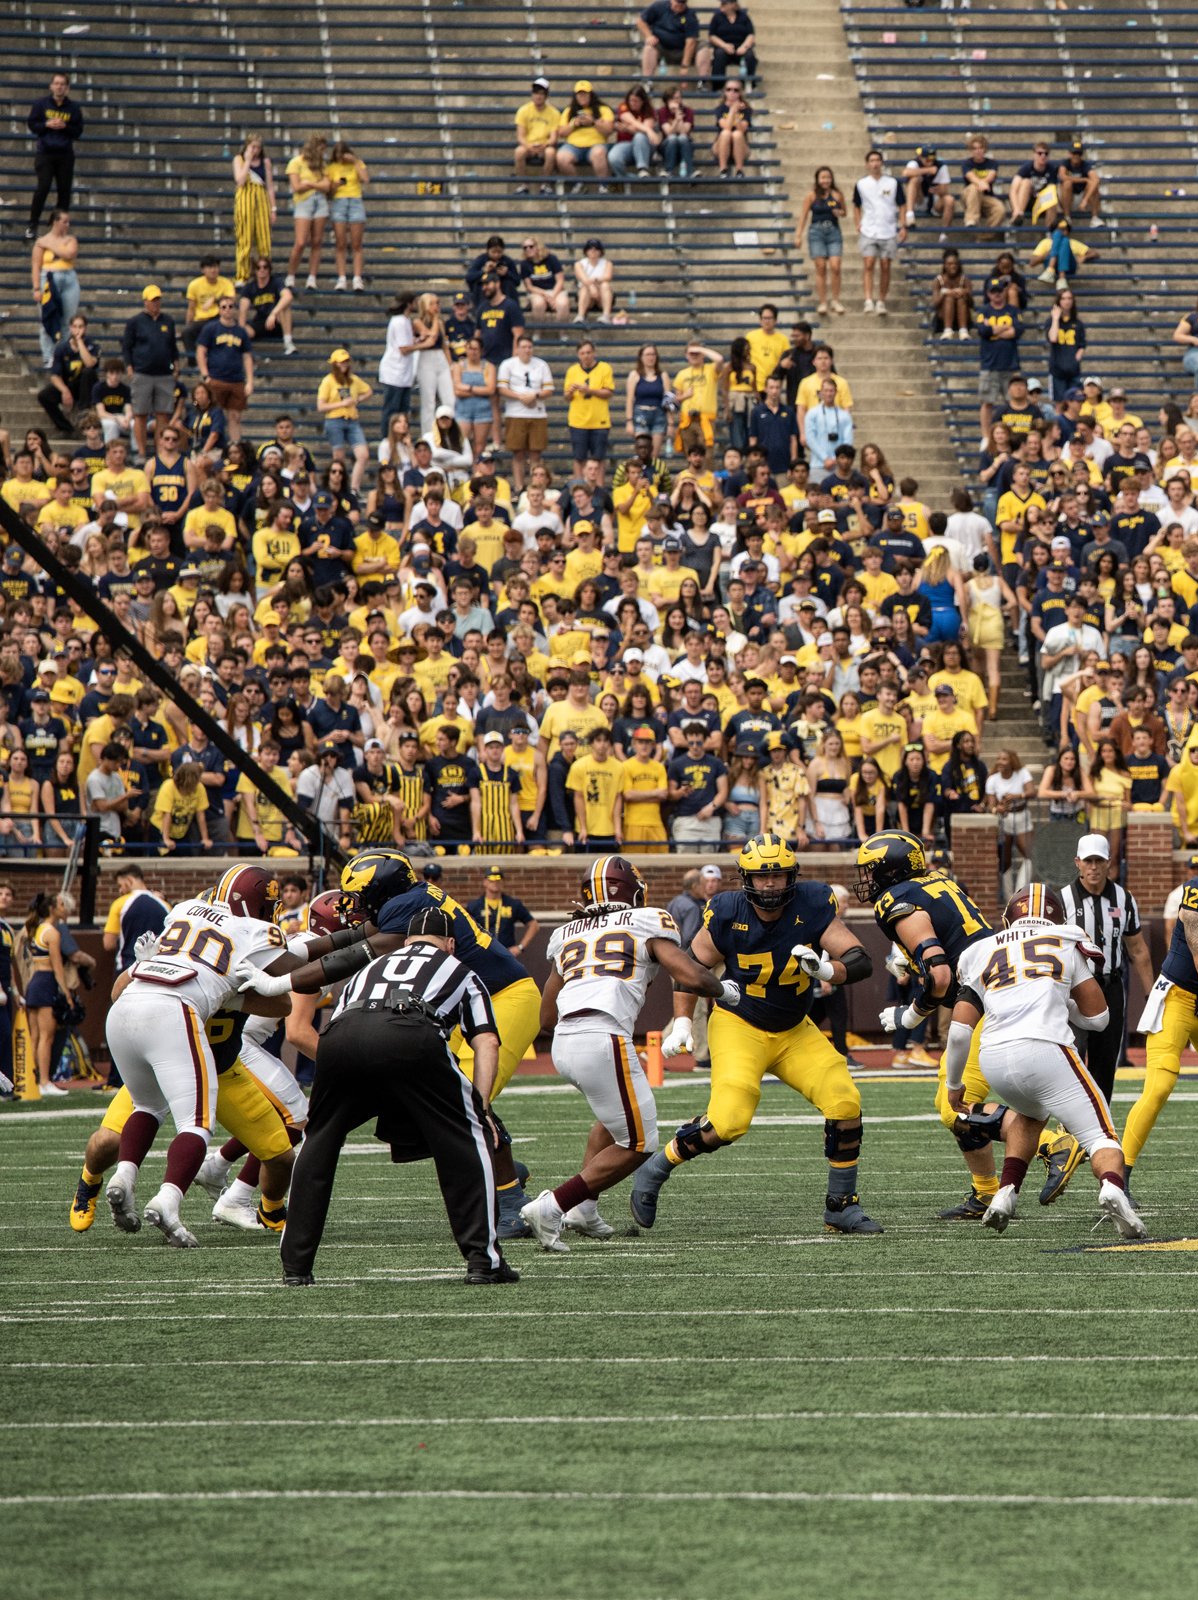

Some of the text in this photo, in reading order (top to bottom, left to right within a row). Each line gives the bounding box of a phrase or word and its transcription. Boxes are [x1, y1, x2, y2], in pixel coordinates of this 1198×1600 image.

[160, 486, 178, 502] 30
[186, 905, 229, 927] CONDE
[562, 911, 634, 940] THOMAS JR.
[1076, 907, 1083, 917] S
[995, 928, 1039, 946] WHITE
[1113, 927, 1121, 938] R
[157, 920, 235, 978] 90
[560, 930, 637, 983] 29
[382, 955, 432, 982] U
[737, 943, 813, 999] 74
[980, 936, 1065, 992] 45
[1155, 979, 1170, 991] M
[15, 1028, 26, 1093] MICHIGAN
